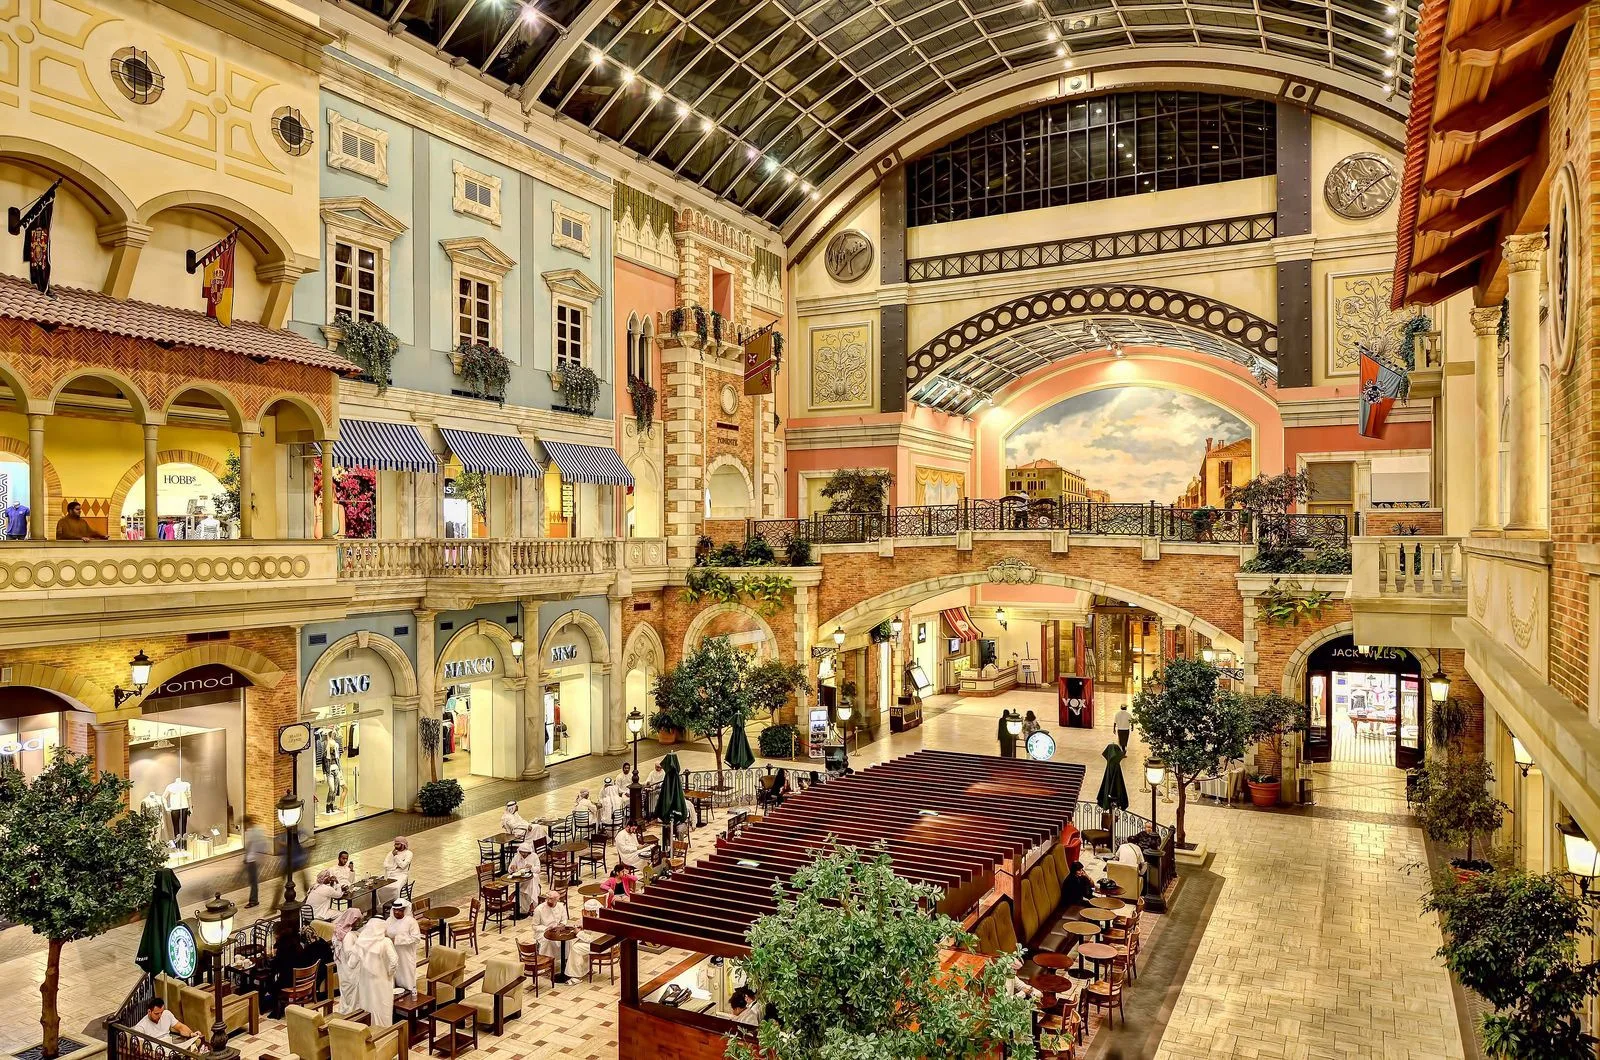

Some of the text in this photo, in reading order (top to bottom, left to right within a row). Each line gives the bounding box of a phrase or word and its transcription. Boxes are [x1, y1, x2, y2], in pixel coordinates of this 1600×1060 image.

[552, 645, 577, 662] MNG
[1331, 648, 1359, 658] JACK
[445, 656, 495, 679] MANGO
[151, 673, 233, 695] romod
[329, 674, 371, 697] MNG
[1062, 697, 1087, 709] VOX
